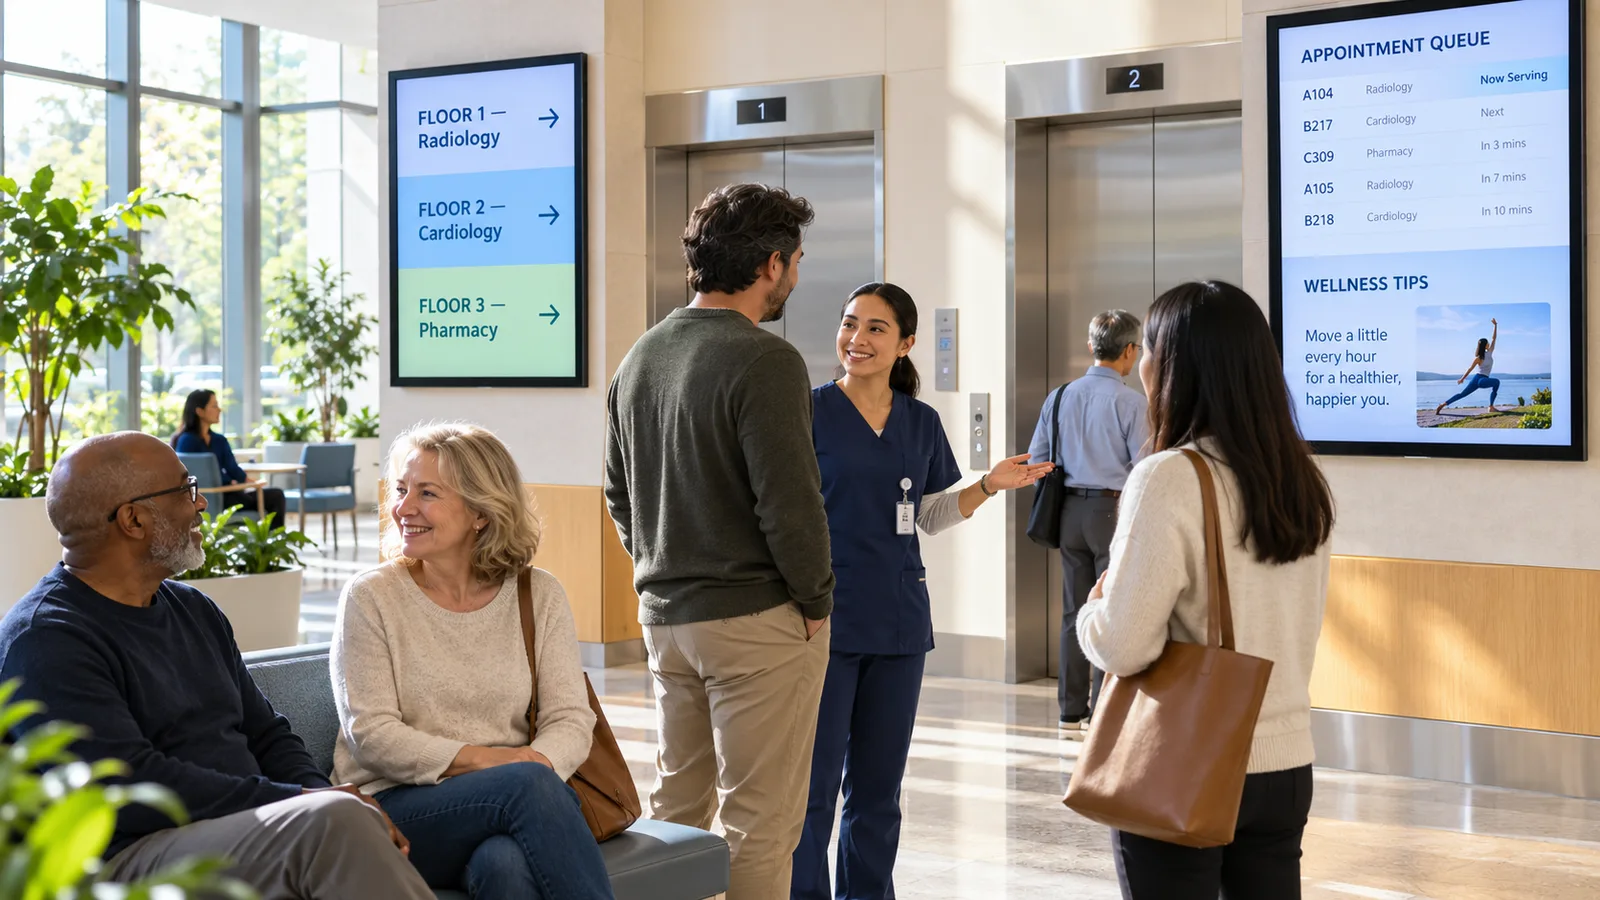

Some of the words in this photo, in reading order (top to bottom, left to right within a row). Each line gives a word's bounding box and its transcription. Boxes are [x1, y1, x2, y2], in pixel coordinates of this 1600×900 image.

[1300, 36, 1425, 64] APPOINTMENT
[1430, 30, 1491, 52] QUEUE
[1128, 69, 1141, 89] 2
[1302, 87, 1334, 102] A104
[1365, 81, 1414, 95] Radiology
[1480, 74, 1504, 85] Now
[1507, 69, 1549, 84] Serving
[417, 106, 473, 126] FLOOR
[477, 105, 486, 122] 1
[757, 101, 766, 120] 1
[1303, 118, 1333, 133] B217
[1365, 113, 1417, 127] Cardiology
[1480, 106, 1505, 118] Next
[417, 129, 501, 150] Radiology
[1303, 150, 1335, 164] C309
[1366, 147, 1414, 160] Pharmacy
[1480, 140, 1491, 151] In
[1493, 139, 1500, 150] 3
[1502, 138, 1527, 150] mins
[1303, 181, 1335, 196] A105
[1366, 178, 1414, 191] Radiology
[1481, 173, 1491, 184] In
[1493, 173, 1500, 183] 7
[1502, 171, 1527, 183] mins
[418, 201, 472, 218] FLOOR
[475, 199, 486, 215] 2
[1304, 213, 1335, 227] B218
[1366, 210, 1418, 223] Cardiology
[1481, 206, 1491, 217] In
[1493, 205, 1506, 216] 10
[1508, 204, 1533, 216] mins
[418, 222, 503, 243] Cardiology
[1303, 276, 1389, 293] WELLNESS
[1392, 274, 1429, 291] TIPS
[419, 297, 472, 314] FLOOR
[475, 296, 486, 313] 3
[419, 321, 499, 342] Pharmacy
[1304, 329, 1343, 343] Move
[1345, 331, 1354, 342] a
[1357, 327, 1388, 342] little
[1304, 352, 1342, 367] every
[1345, 349, 1377, 363] hour
[1304, 370, 1325, 385] for
[1327, 373, 1336, 385] a
[1339, 369, 1402, 387] healthier,
[1305, 392, 1357, 409] happier
[1360, 394, 1390, 410] you.
